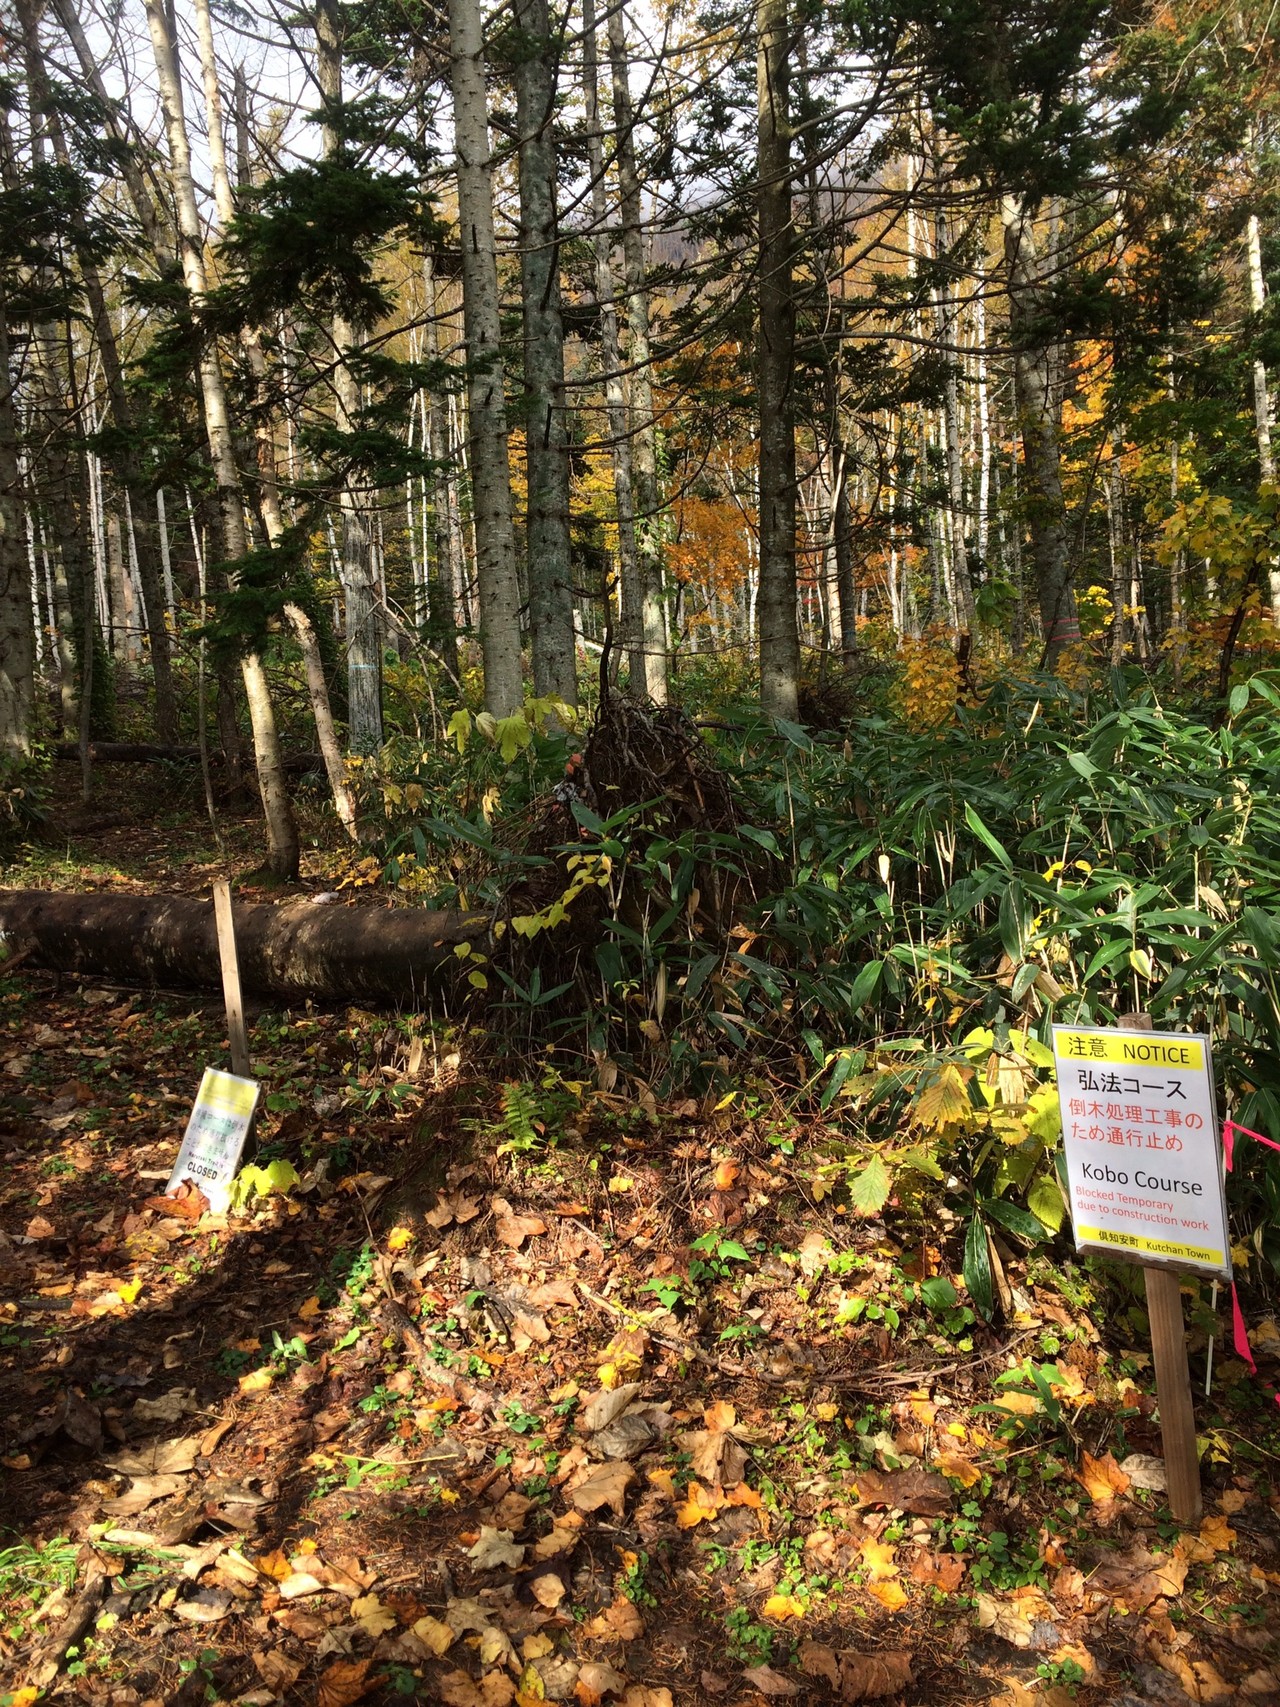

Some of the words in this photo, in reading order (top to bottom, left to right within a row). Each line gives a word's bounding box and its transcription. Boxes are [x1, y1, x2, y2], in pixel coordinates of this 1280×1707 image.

[1068, 1037, 1108, 1058] 注意
[1123, 1044, 1190, 1064] NOTICE
[1077, 1069, 1187, 1100] 弘法コース
[1068, 1098, 1203, 1130] 倒木処理工事の
[1071, 1122, 1183, 1152] ため通行止め
[186, 1160, 218, 1181] CLOSED
[1082, 1162, 1129, 1185] Kobo
[1134, 1171, 1203, 1196] Course
[1075, 1185, 1114, 1201] Blocked
[1117, 1193, 1174, 1213] Temporary
[1077, 1200, 1096, 1212] due
[1099, 1204, 1110, 1214] to
[1112, 1207, 1178, 1226] construction
[1181, 1217, 1209, 1231] work
[1146, 1241, 1183, 1255] Kutchan
[1185, 1248, 1211, 1260] Town
